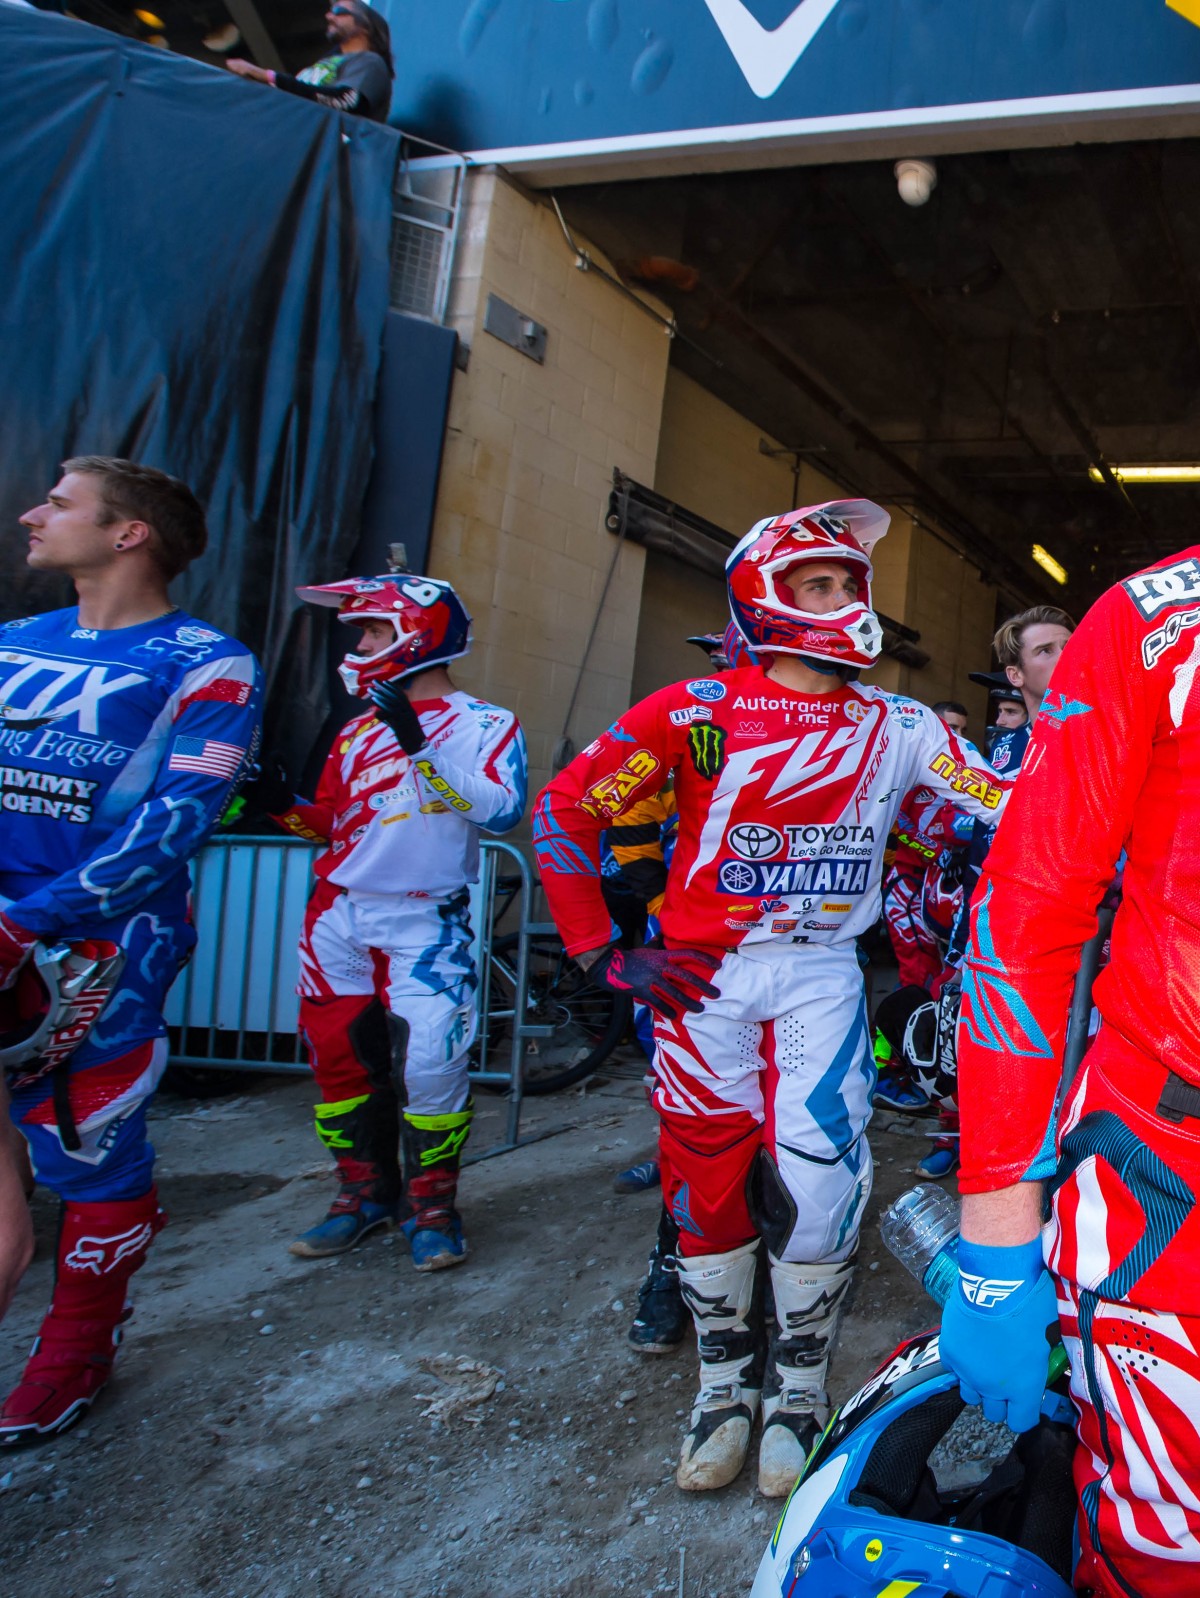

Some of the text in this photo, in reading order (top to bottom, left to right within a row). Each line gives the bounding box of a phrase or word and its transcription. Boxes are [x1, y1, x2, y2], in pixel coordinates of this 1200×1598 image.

[236, 686, 250, 704] USA
[732, 696, 840, 714] Autotrader
[891, 706, 924, 717] AMA
[24, 729, 127, 768] Eagle
[0, 768, 98, 799] IMMY
[0, 792, 92, 823] OHN'S
[786, 826, 875, 844] TOYOTA
[790, 843, 873, 858] Let's Go Places
[761, 863, 867, 893] YAMAHA
